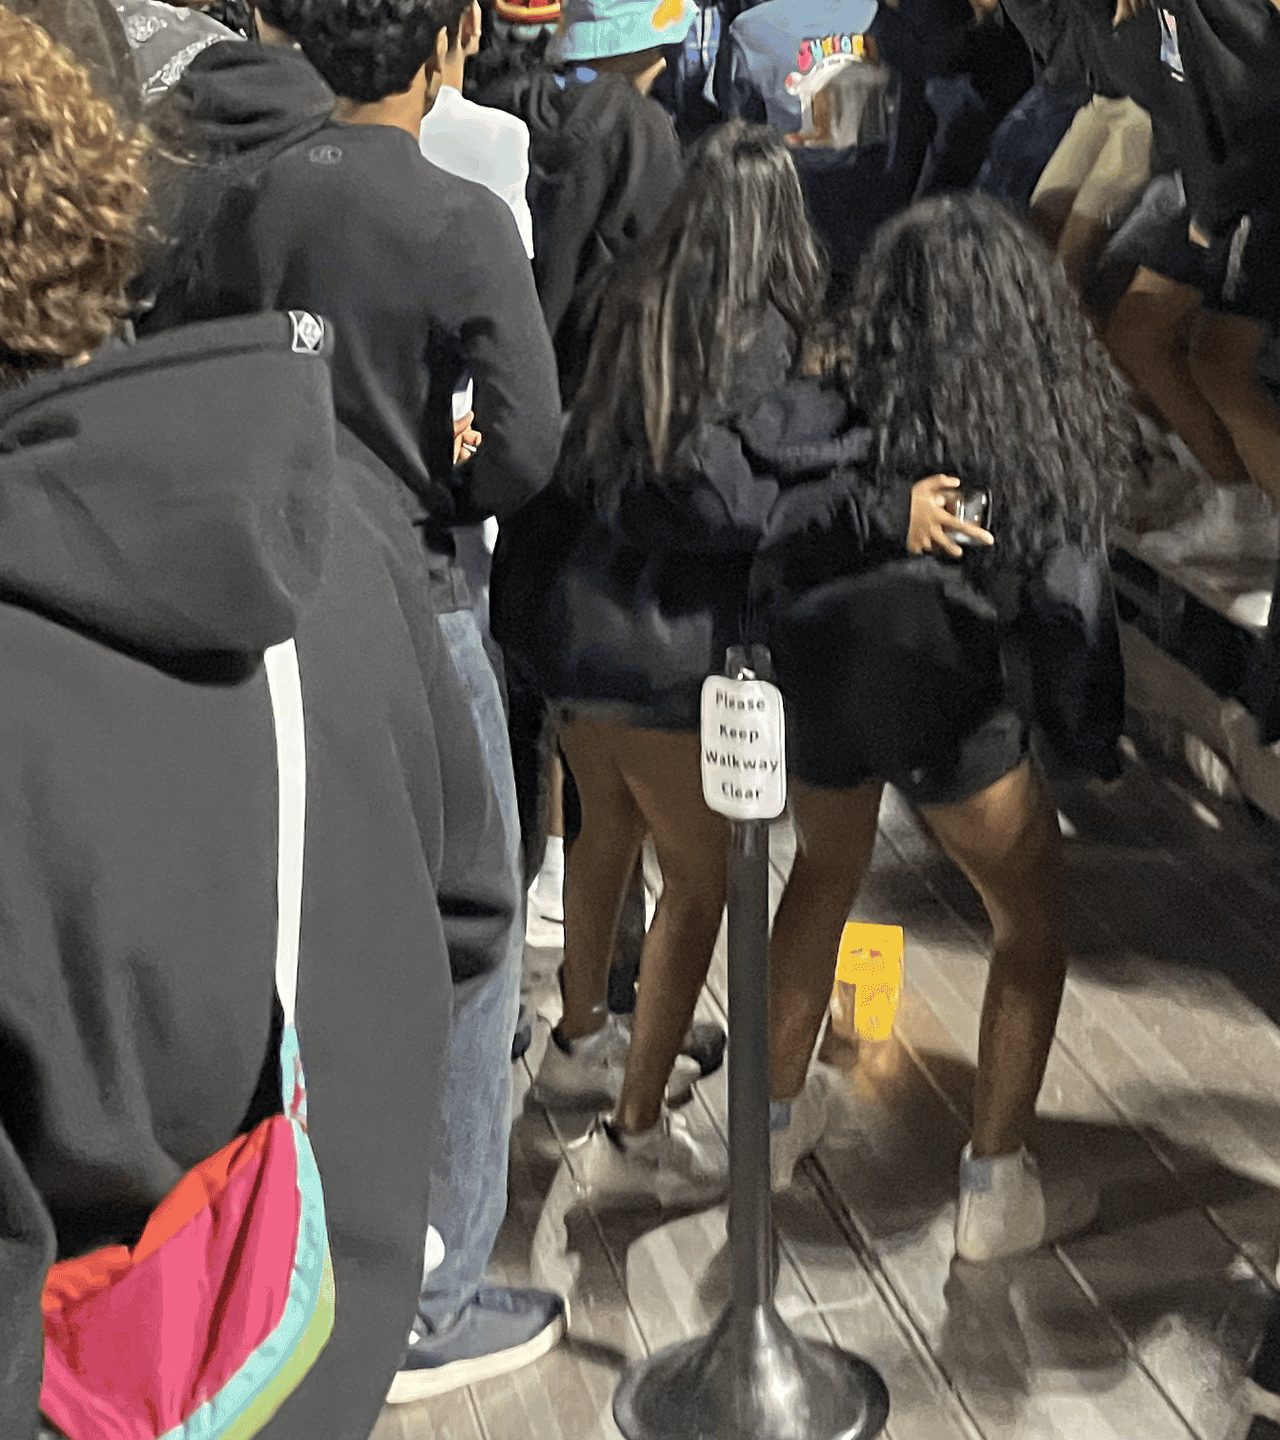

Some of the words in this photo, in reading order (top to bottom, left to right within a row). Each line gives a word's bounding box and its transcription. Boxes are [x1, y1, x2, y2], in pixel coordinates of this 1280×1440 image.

[715, 688, 765, 712] Please
[719, 723, 759, 744] Keep
[705, 748, 779, 772] Walkway
[721, 781, 761, 800] Clear
